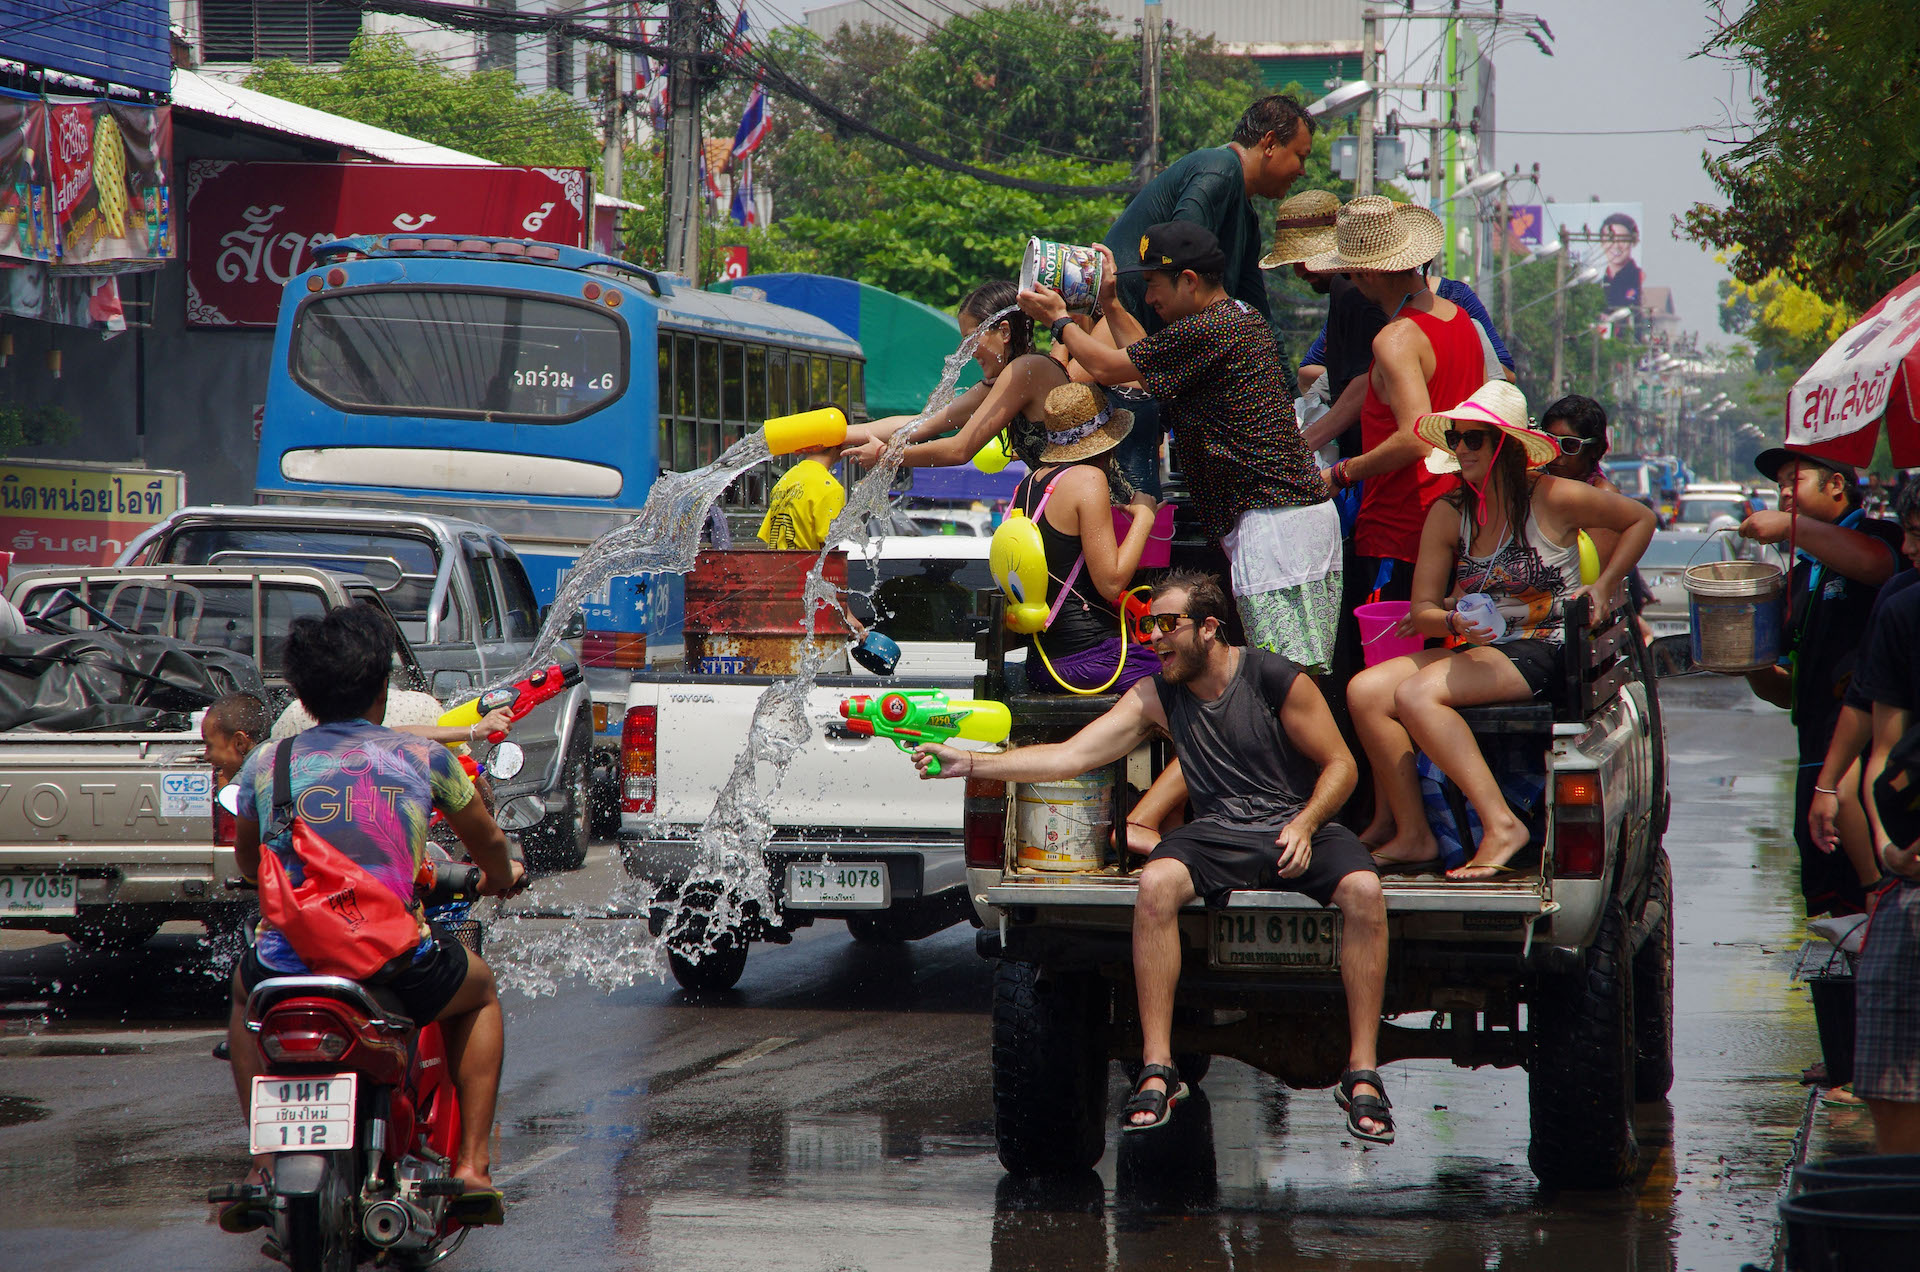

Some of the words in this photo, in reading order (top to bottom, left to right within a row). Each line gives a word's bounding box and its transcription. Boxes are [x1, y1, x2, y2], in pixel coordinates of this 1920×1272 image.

[1043, 241, 1057, 290] YNOTEX
[513, 365, 574, 388] รถร่วม
[0, 474, 163, 515] นิดหน่อยไอที
[12, 529, 150, 555] รับฝา
[670, 694, 715, 704] TOYOTA
[931, 715, 950, 726] 1250
[22, 877, 73, 898] 7035
[837, 870, 880, 888] 4078
[276, 1106, 329, 1121] เชียงใหม่
[280, 1125, 327, 1146] 112
